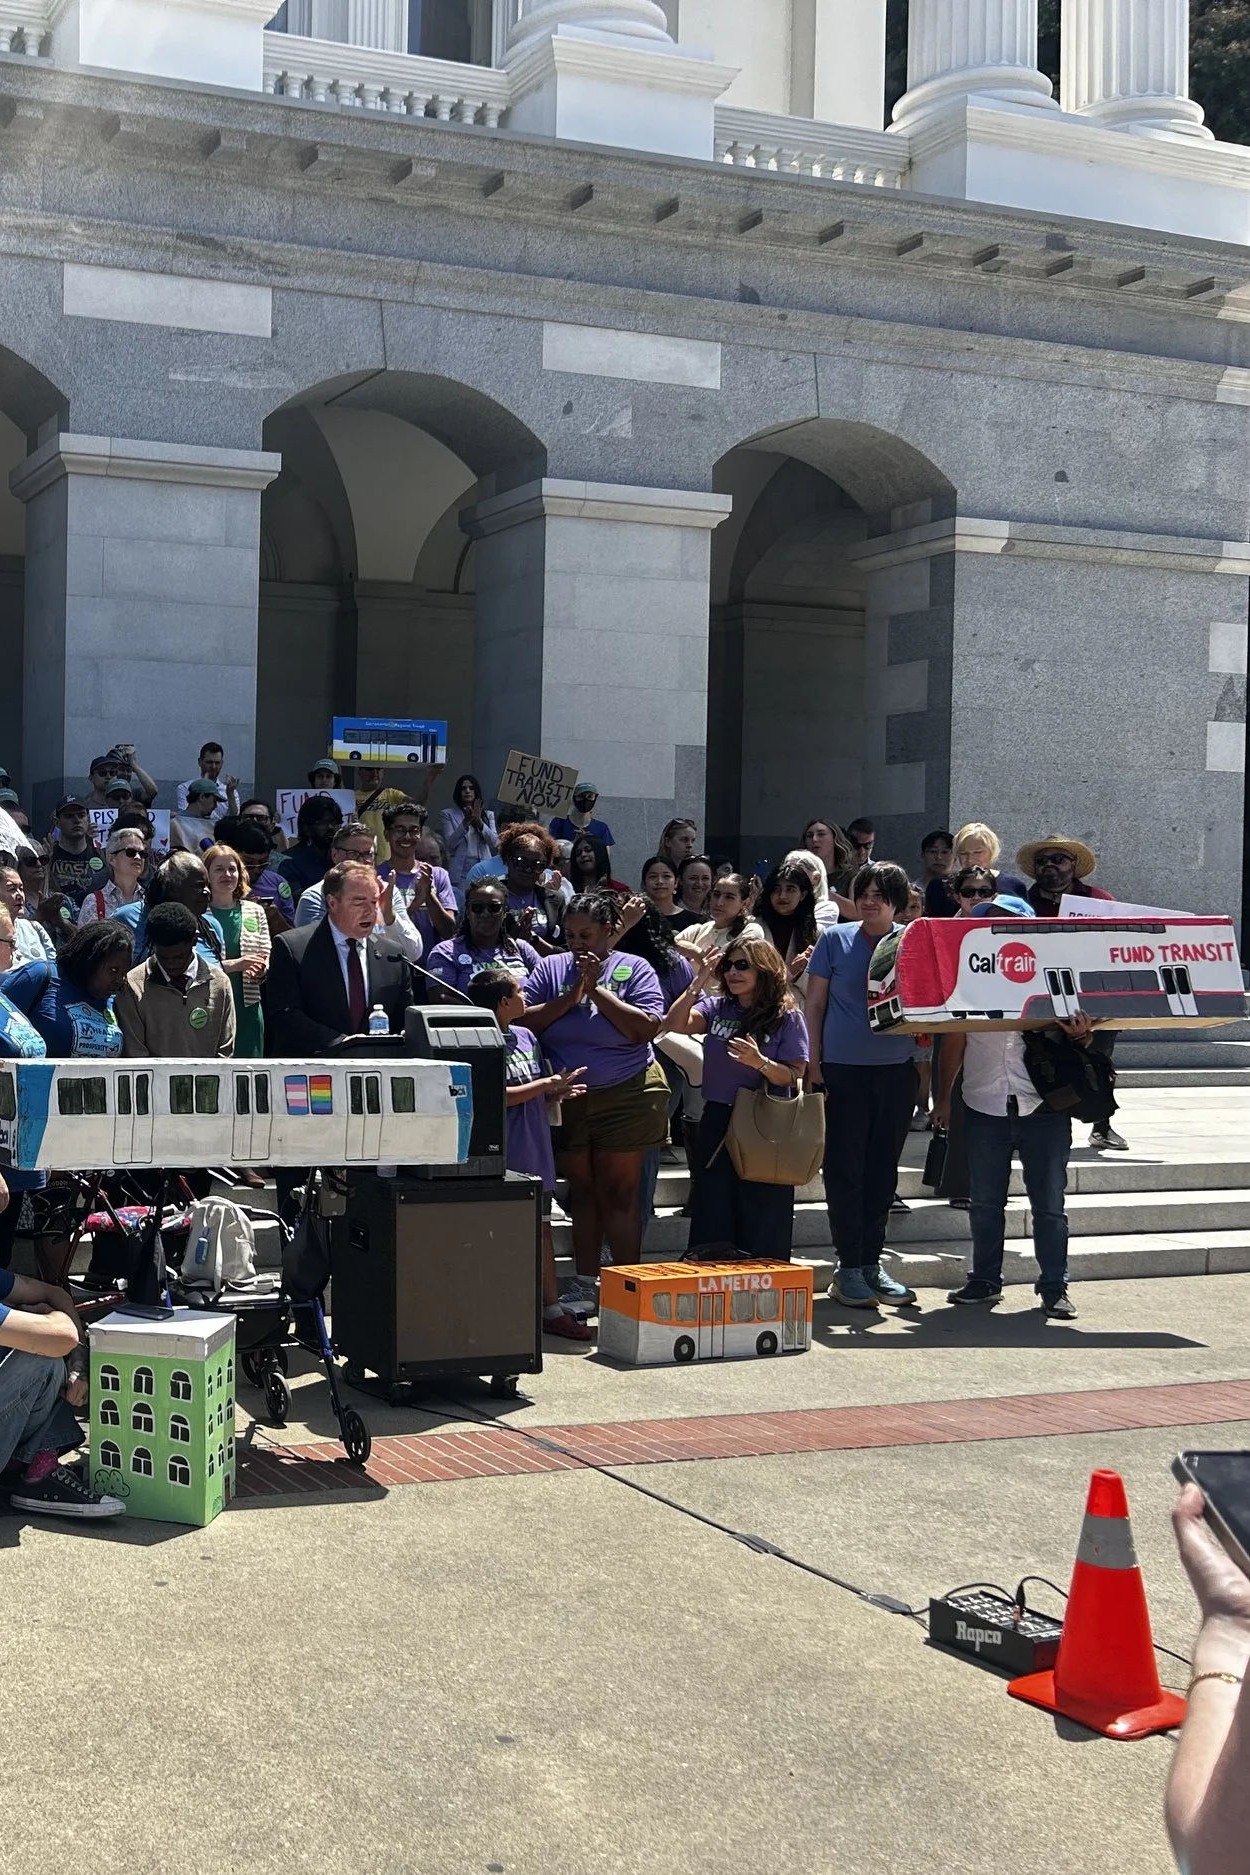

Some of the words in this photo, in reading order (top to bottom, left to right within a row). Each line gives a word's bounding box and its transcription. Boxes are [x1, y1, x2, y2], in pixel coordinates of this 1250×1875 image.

[519, 756, 563, 783] FUND
[507, 768, 574, 800] TRANSIT
[516, 788, 561, 809] NOW
[93, 810, 114, 825] PLS
[968, 951, 1037, 975] Caltrain
[1109, 945, 1155, 964] FUND
[1158, 942, 1235, 963] TRANSIT
[698, 1276, 717, 1292] LA
[720, 1273, 773, 1291] METRO
[955, 1620, 1002, 1652] Rapco
